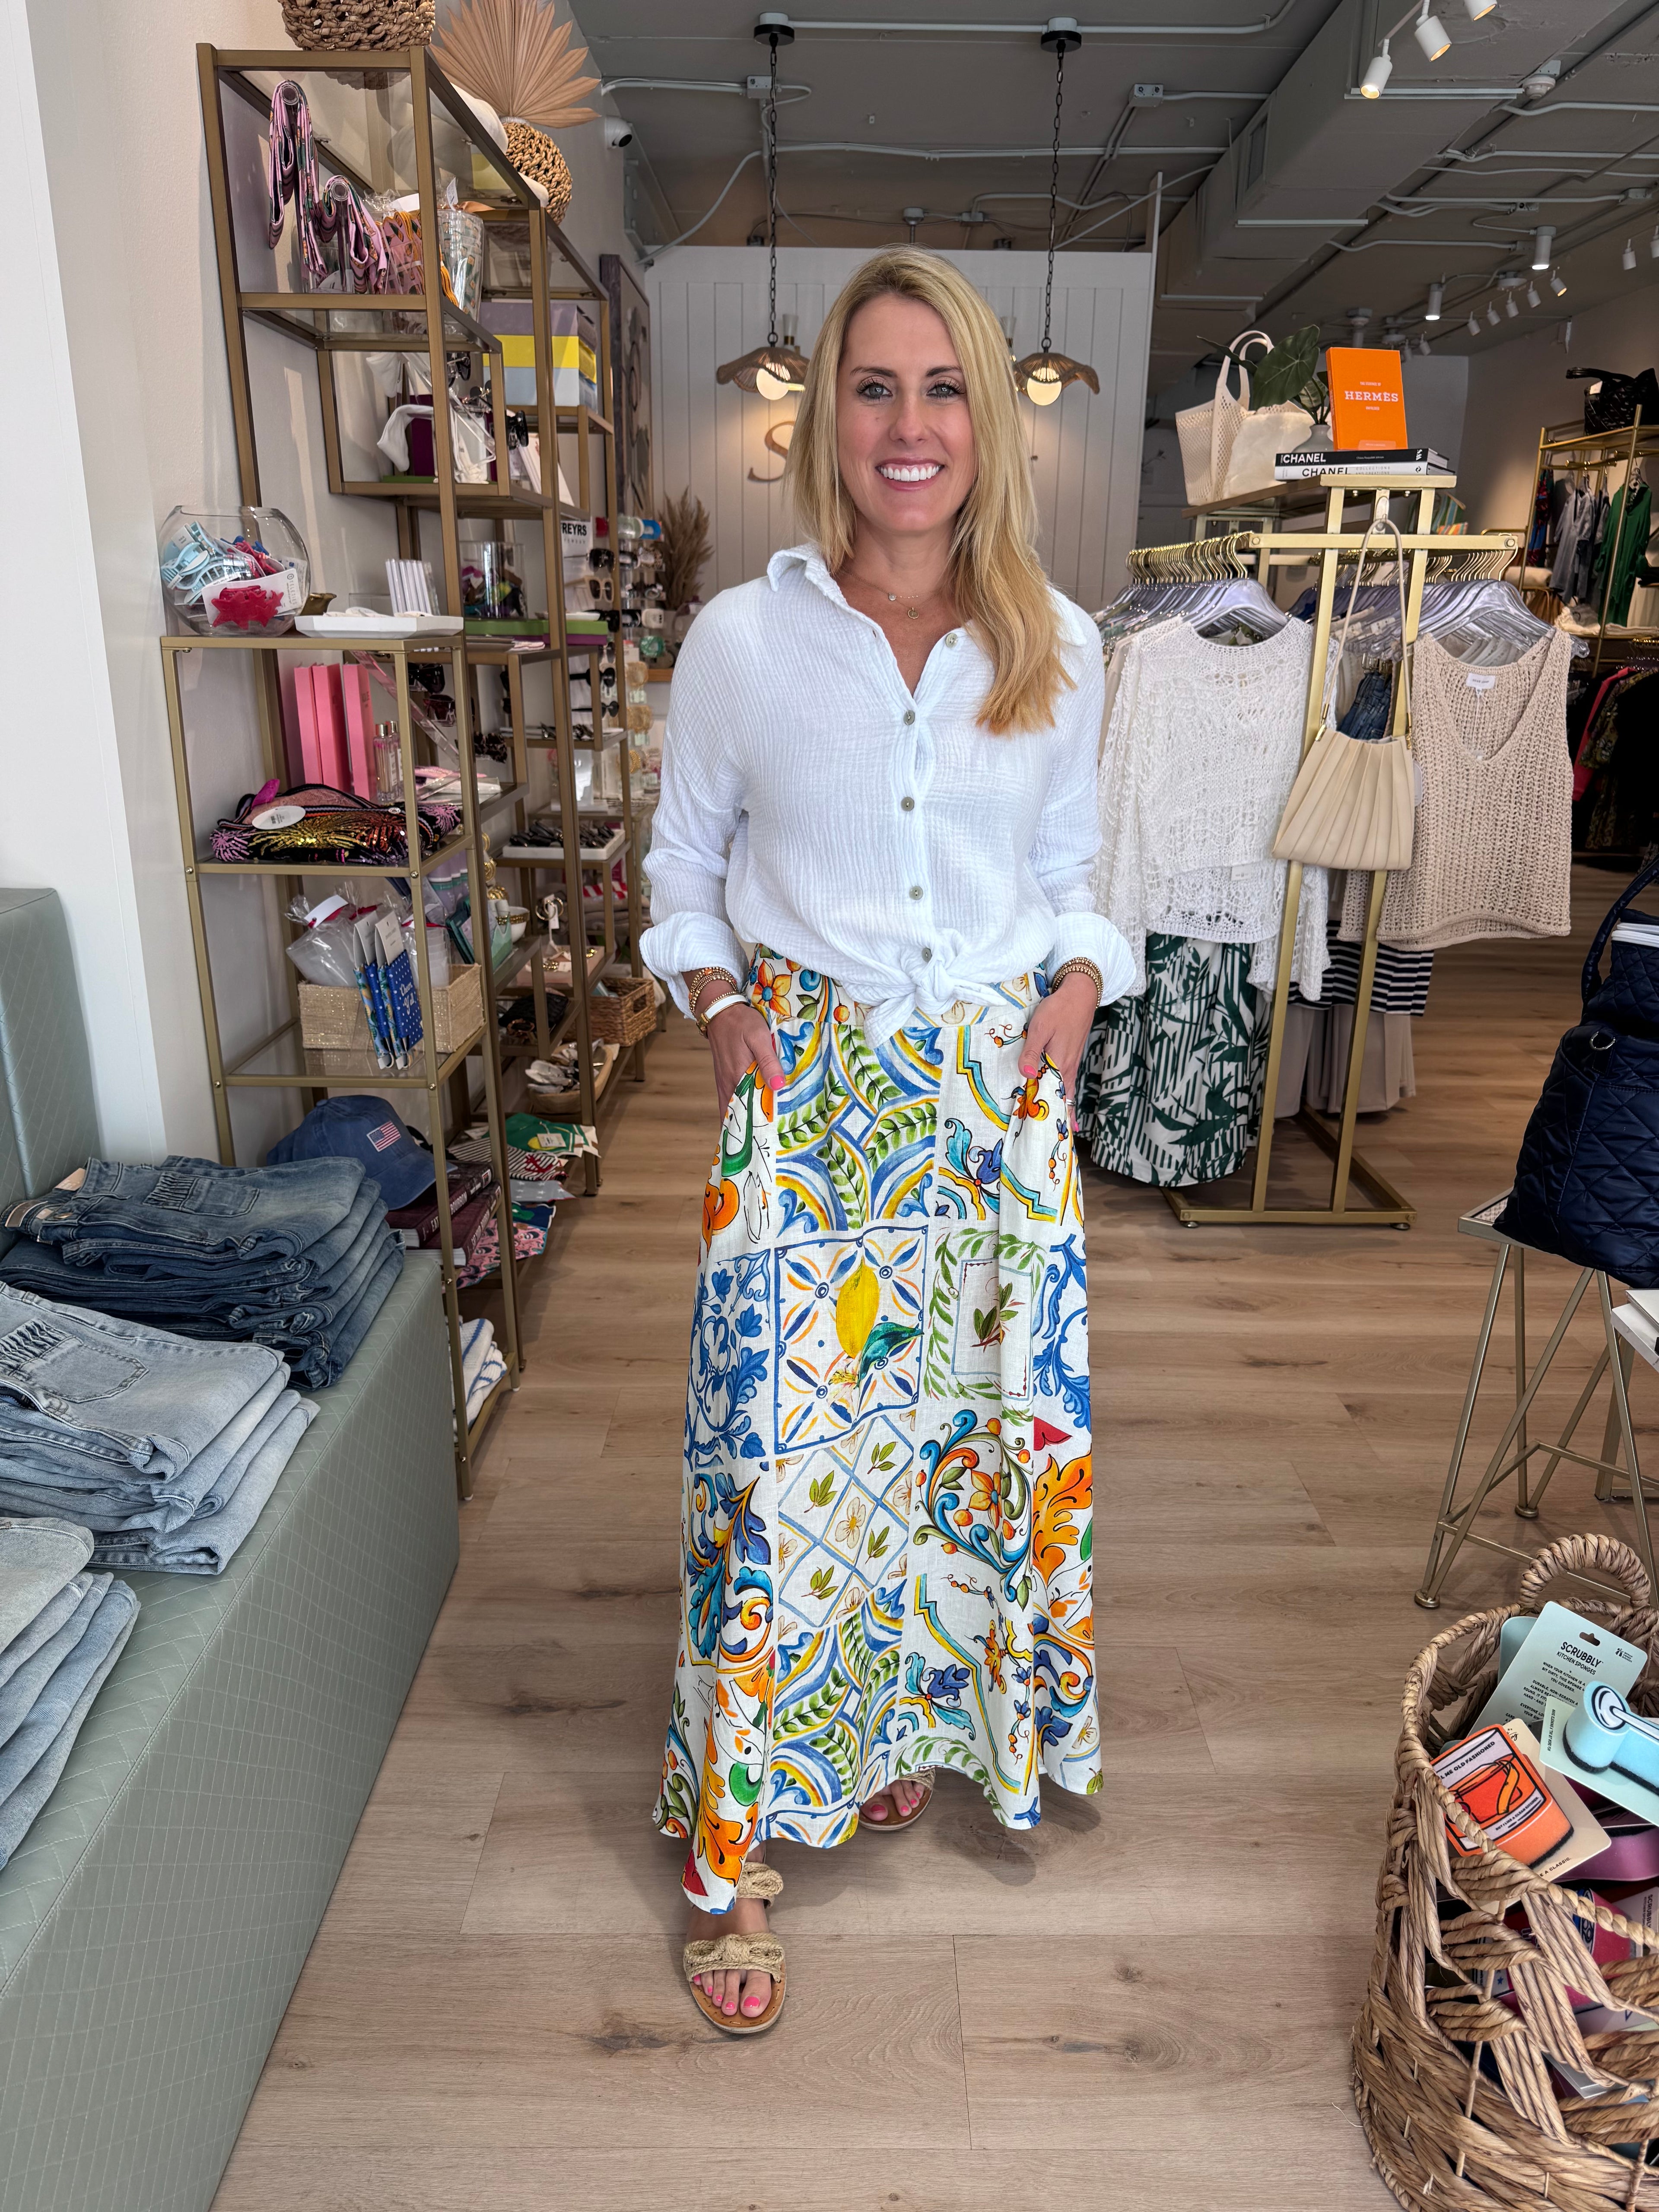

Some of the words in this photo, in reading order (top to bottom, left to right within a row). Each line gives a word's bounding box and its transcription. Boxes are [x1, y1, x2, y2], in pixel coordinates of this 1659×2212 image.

[1283, 453, 1326, 464] CHANEL
[561, 522, 587, 536] REYRS
[1560, 1642, 1601, 1668] SCRUBBLY
[1557, 1652, 1575, 1664] KITCHEN
[1575, 1661, 1596, 1675] SPONGES
[1563, 1672, 1578, 1681] KITCHEN
[1530, 1685, 1544, 1693] ALWAYS
[1568, 1681, 1582, 1690] SPONGE
[1520, 1703, 1538, 1713] EVERYONE
[1454, 1762, 1465, 1771] OLD
[1465, 1742, 1495, 1764] FASHIONED
